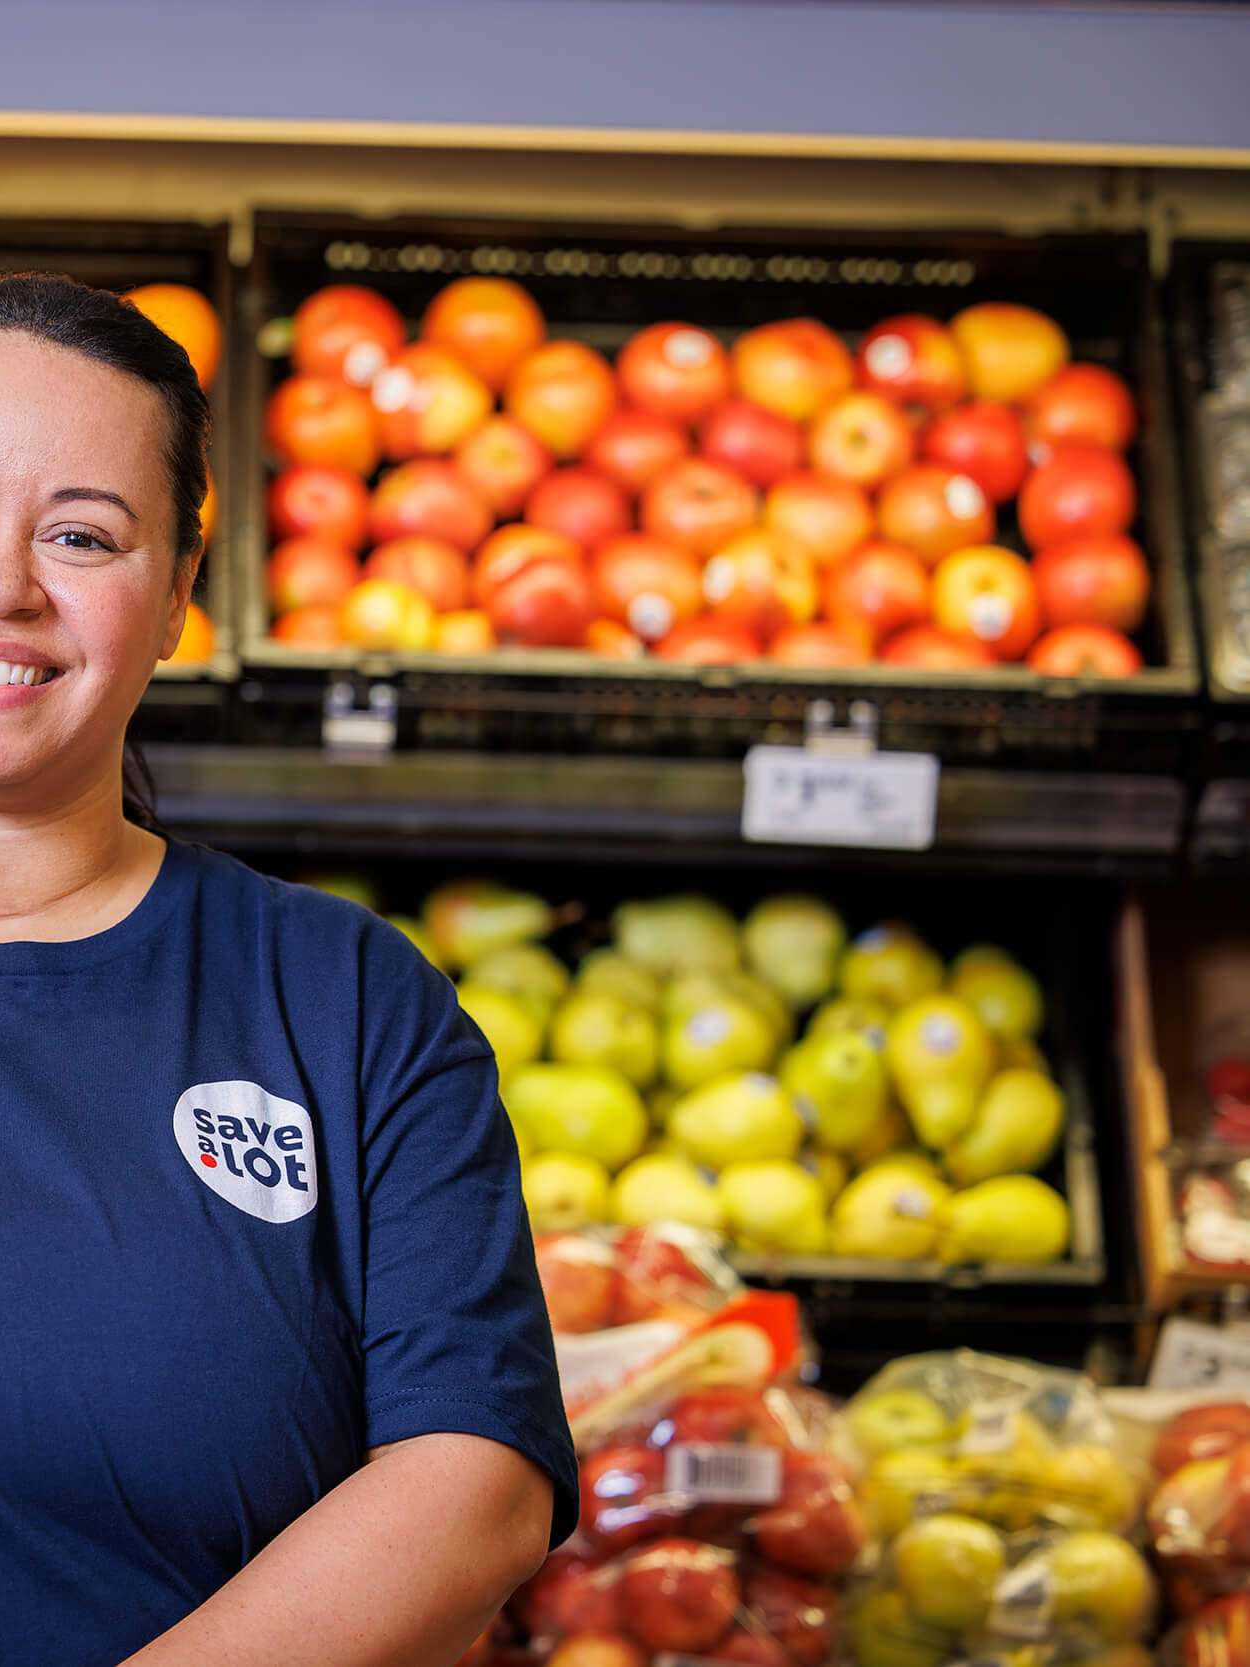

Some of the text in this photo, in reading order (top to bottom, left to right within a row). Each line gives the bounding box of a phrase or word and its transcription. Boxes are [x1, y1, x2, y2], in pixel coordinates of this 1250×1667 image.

[192, 1107, 304, 1152] save
[197, 1134, 309, 1192] a lot
